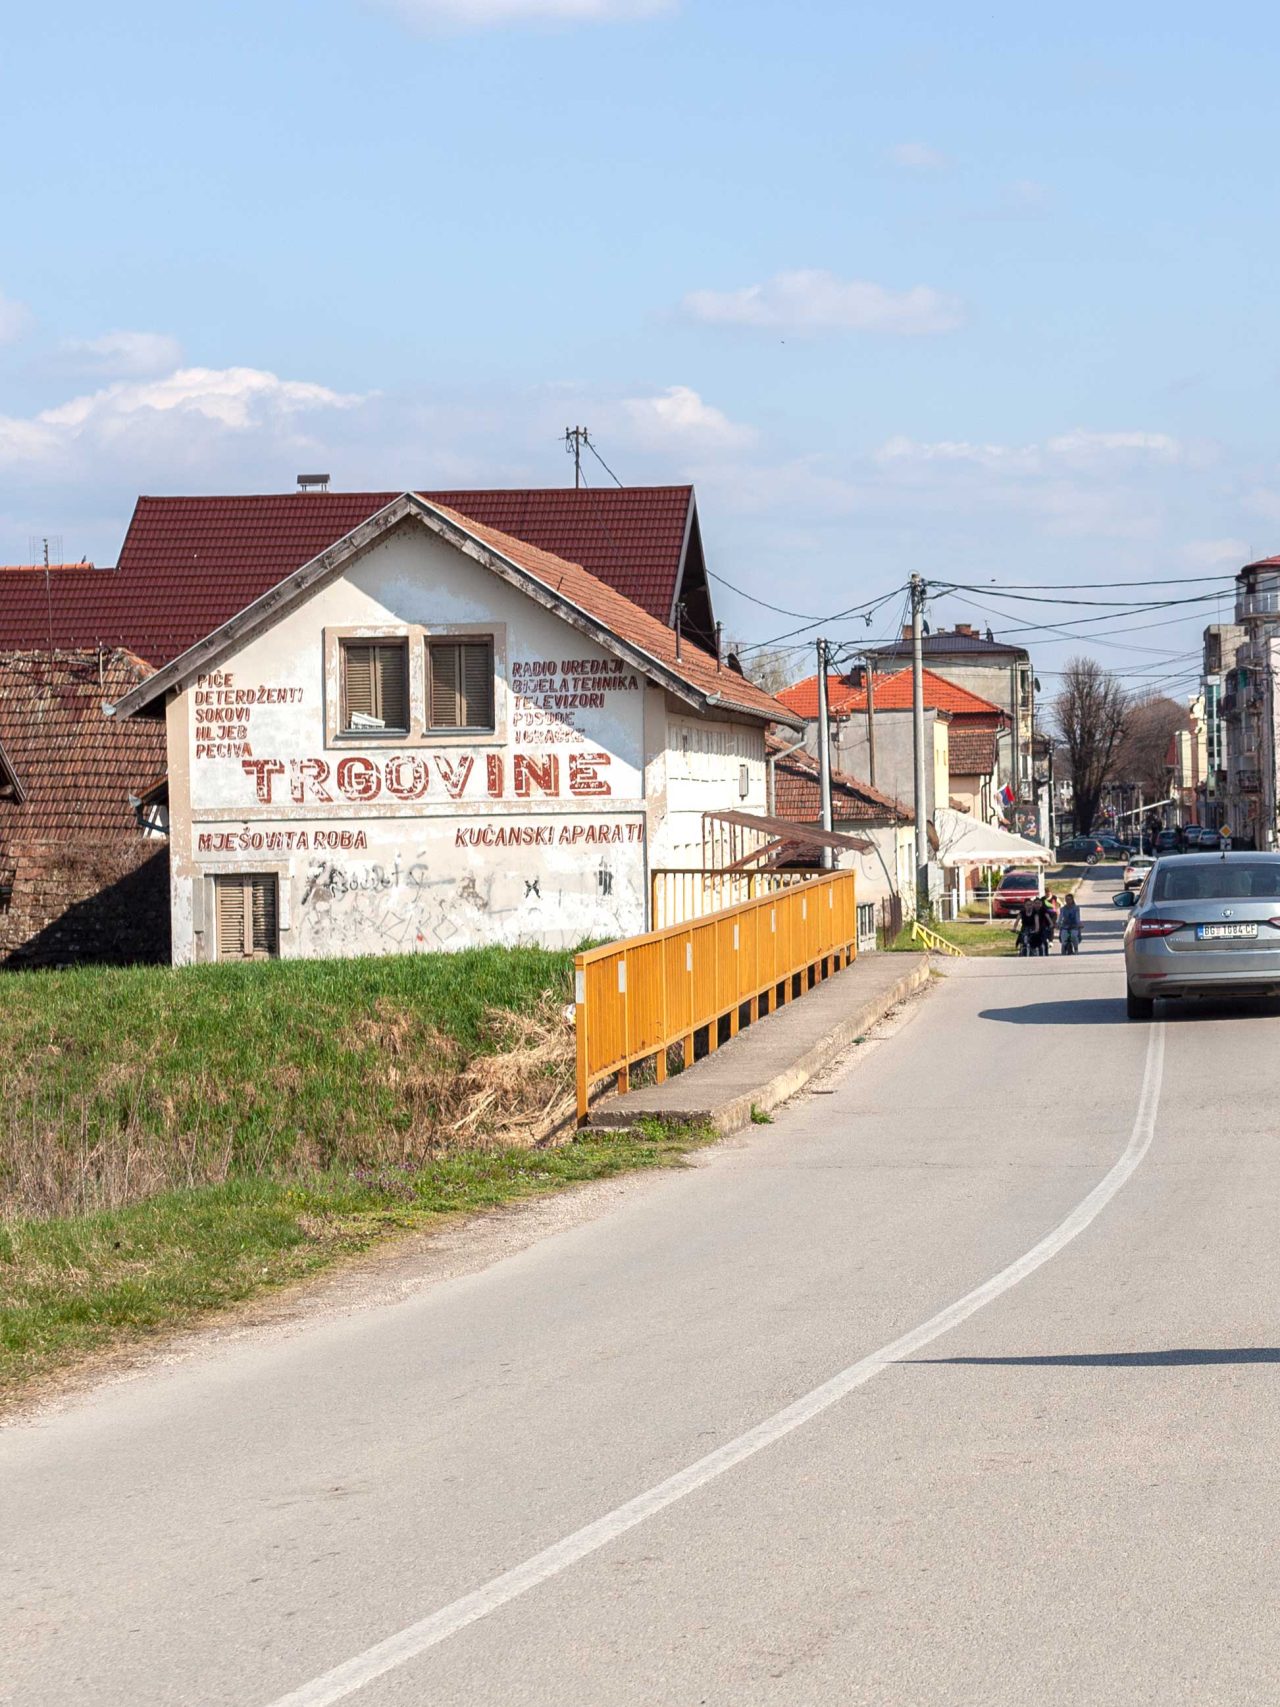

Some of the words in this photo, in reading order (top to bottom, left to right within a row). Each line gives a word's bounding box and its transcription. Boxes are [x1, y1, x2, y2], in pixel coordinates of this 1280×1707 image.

[512, 661, 557, 677] RADIO
[512, 678, 569, 693] BIJELA
[571, 676, 639, 692] TEHNIKA
[514, 693, 605, 710] TELEVIZORI
[195, 707, 250, 723] SOKOVI
[196, 724, 247, 742] HLJEB
[196, 742, 252, 759] PECIVA
[242, 752, 612, 803] TRGOVINE
[198, 827, 309, 852] MJEŠOVITA
[313, 830, 368, 851] ROBA
[558, 823, 643, 845] APARATI
